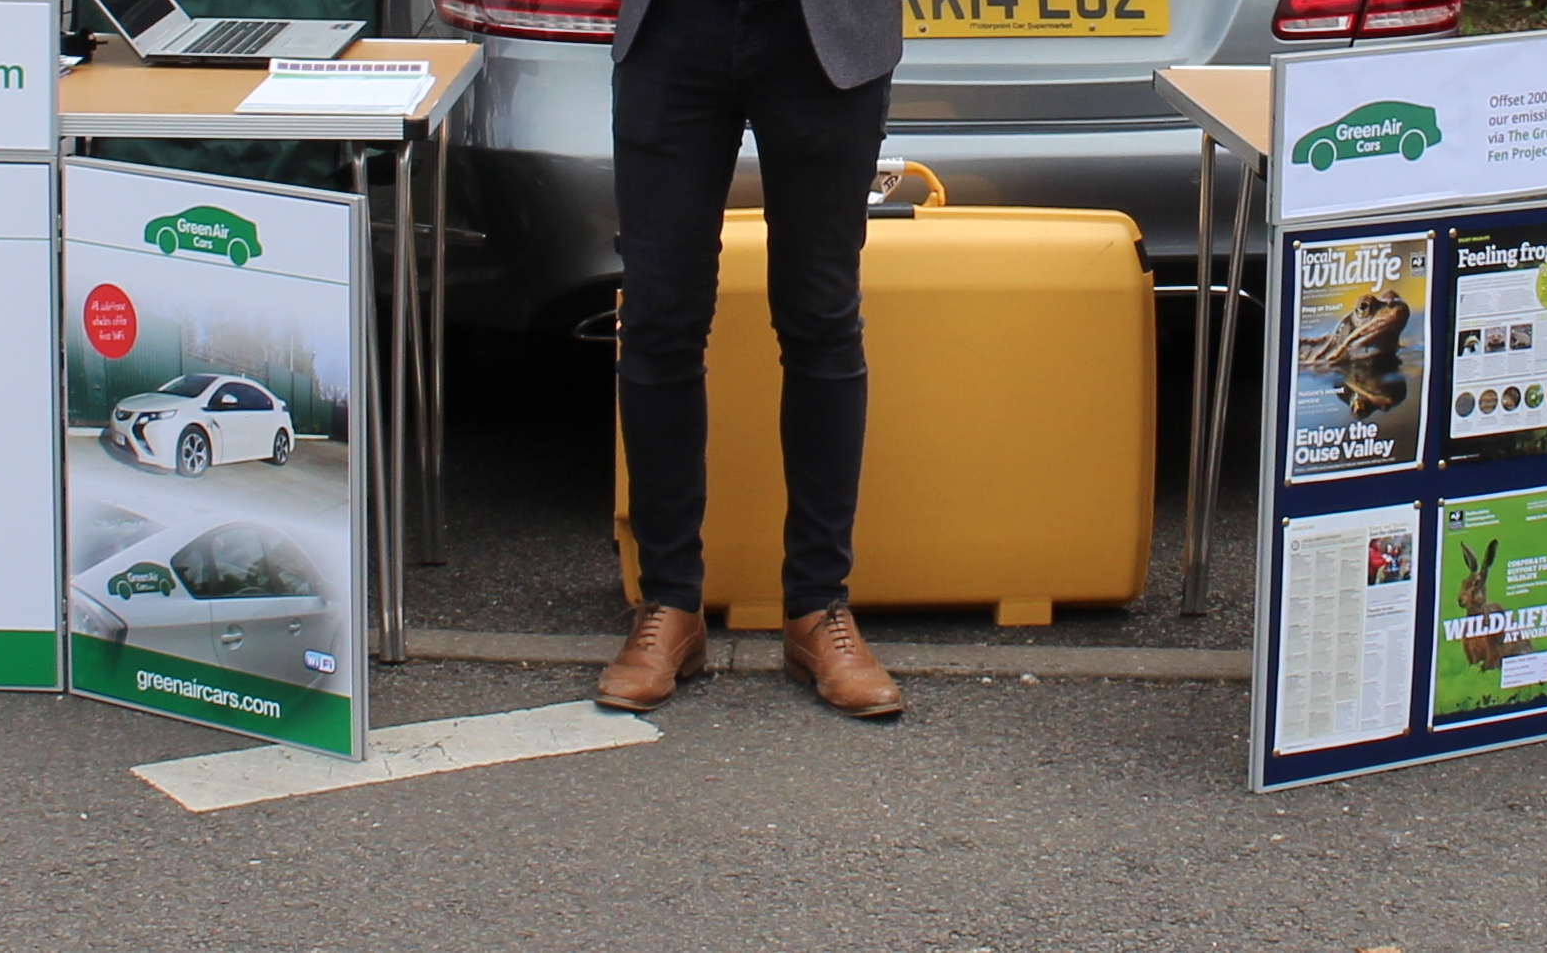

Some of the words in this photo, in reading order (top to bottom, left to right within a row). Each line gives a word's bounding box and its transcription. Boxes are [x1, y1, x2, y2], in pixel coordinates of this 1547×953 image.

[1013, 22, 1027, 30] Car
[1027, 22, 1073, 30] Supermarket
[1489, 94, 1525, 109] Offset
[1488, 113, 1509, 127] our
[1487, 132, 1504, 144] via
[1508, 129, 1529, 142] The
[1356, 139, 1381, 154] Cars
[1487, 149, 1509, 163] Fen
[193, 236, 213, 249] Cars
[1302, 248, 1333, 265] local
[1457, 244, 1518, 268] Feeling
[1302, 248, 1402, 292] wildlife
[1296, 426, 1346, 447] Enjoy
[1349, 421, 1378, 440] the
[1295, 446, 1340, 465] Ouse
[1342, 438, 1395, 459] Valley
[1503, 629, 1520, 643] AT
[137, 669, 281, 718] greenaircars.com
